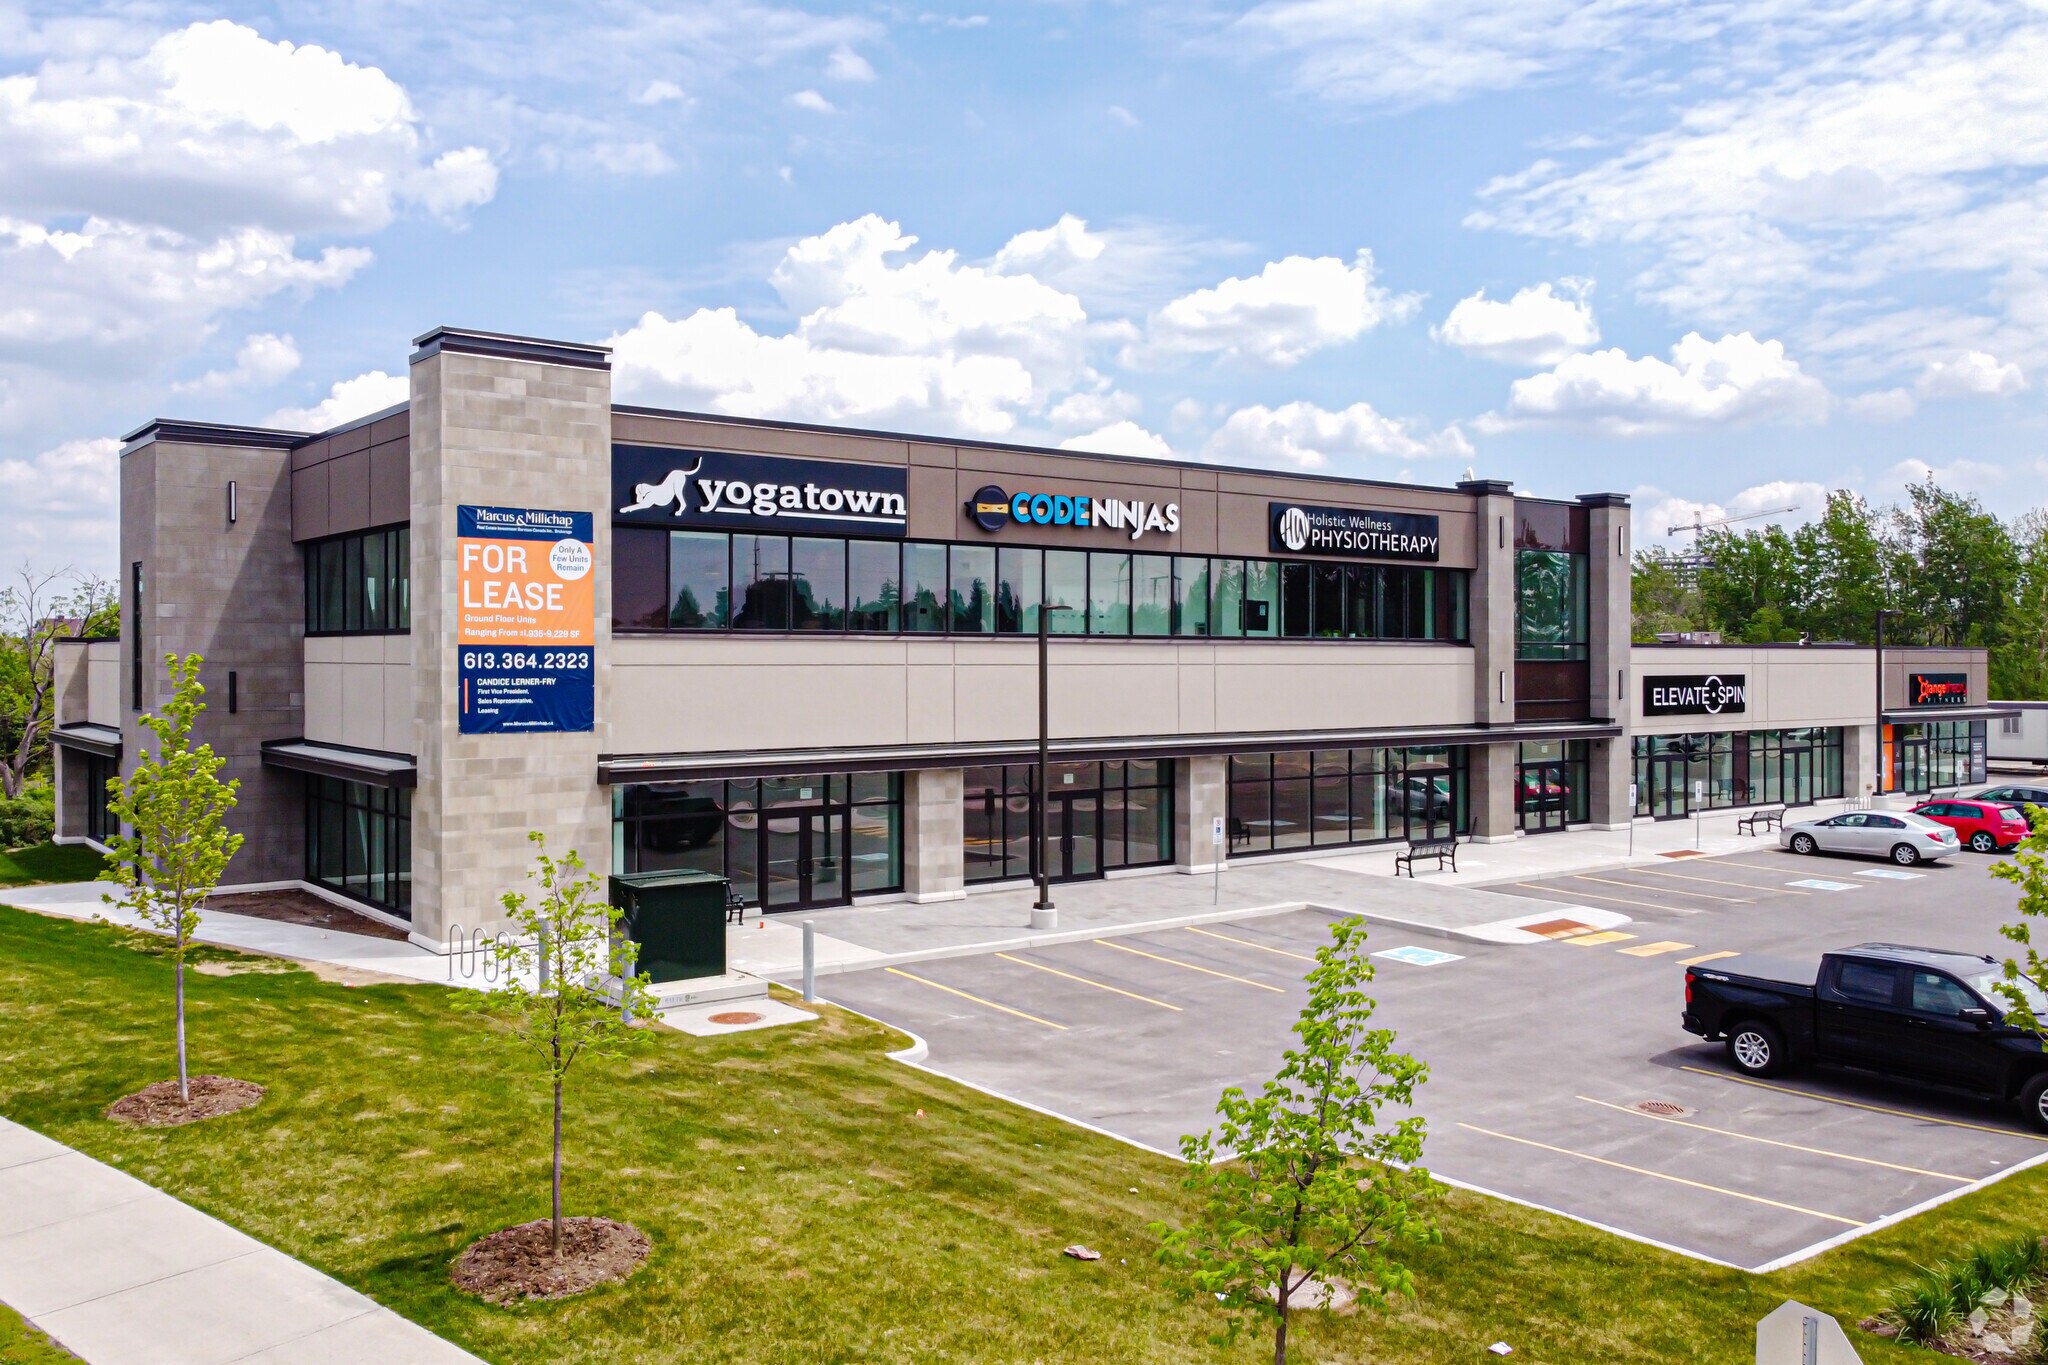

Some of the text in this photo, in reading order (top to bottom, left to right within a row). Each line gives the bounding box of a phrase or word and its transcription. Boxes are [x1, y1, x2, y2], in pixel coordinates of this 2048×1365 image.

[698, 478, 907, 517] yogatown
[476, 509, 573, 528] Marcus & Millichap
[1306, 512, 1391, 531] Holistic Wellness
[558, 545, 575, 555] Only
[1311, 529, 1438, 554] PHYSIOTHERAPY
[463, 543, 528, 574] FOR
[552, 554, 589, 563] Few Units
[556, 563, 585, 571] Remain
[463, 580, 564, 611] LEASE
[464, 614, 537, 624] Ground Floor Units
[464, 628, 497, 638] Ranging
[498, 629, 518, 637] From
[570, 630, 580, 638] SF
[463, 652, 589, 670] 613.364.2323
[477, 678, 557, 686] CANDICE LERNER-FRY
[1653, 685, 1745, 706] ELEVATE SPIN
[1927, 696, 1967, 704] FITNESS
